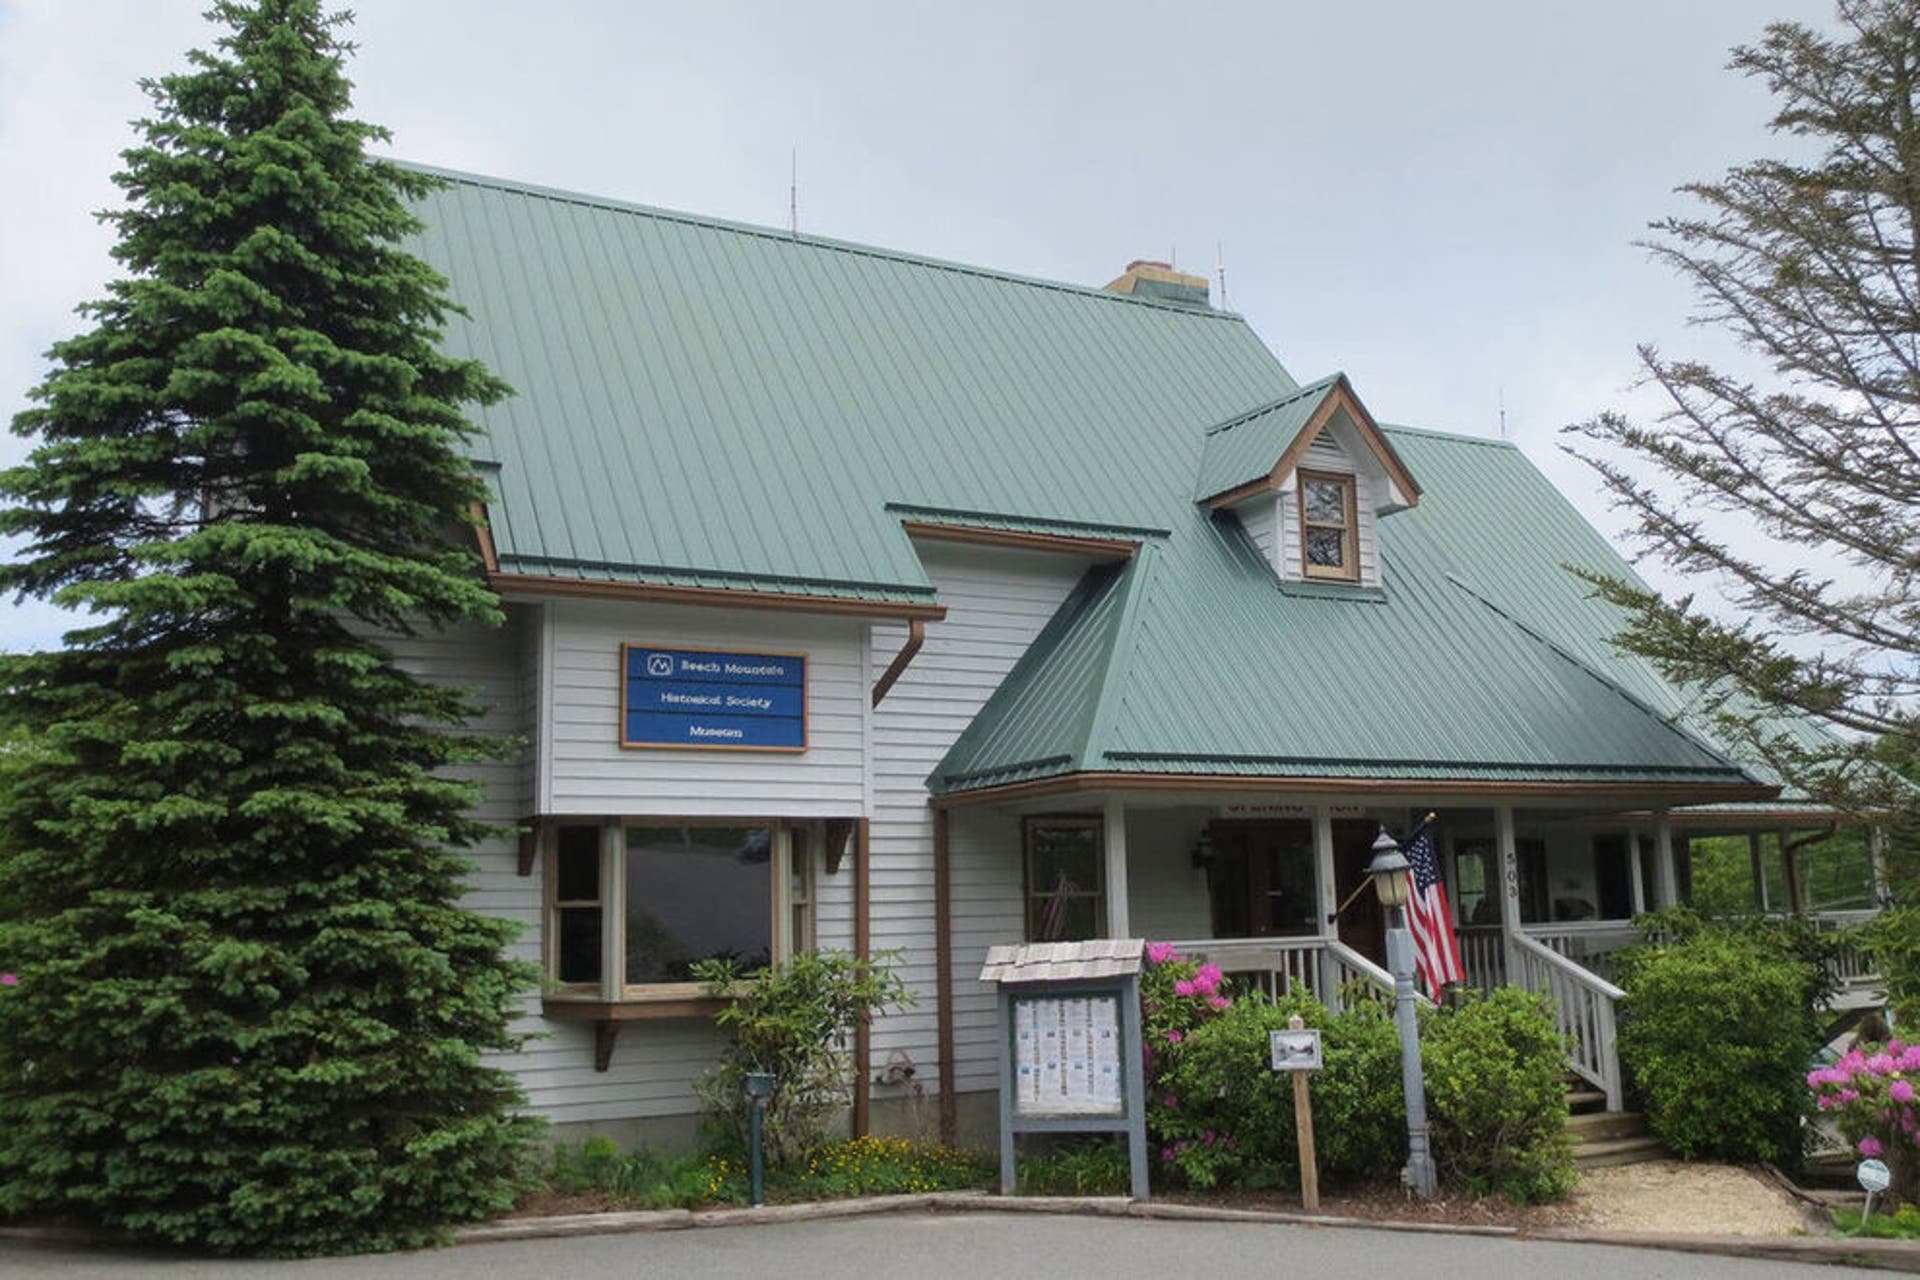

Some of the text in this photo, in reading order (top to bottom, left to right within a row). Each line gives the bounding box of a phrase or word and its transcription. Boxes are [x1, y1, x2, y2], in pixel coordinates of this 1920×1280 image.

[681, 660, 784, 676] Beech Mountain
[661, 692, 772, 709] Historical Society
[689, 726, 743, 739] Museum
